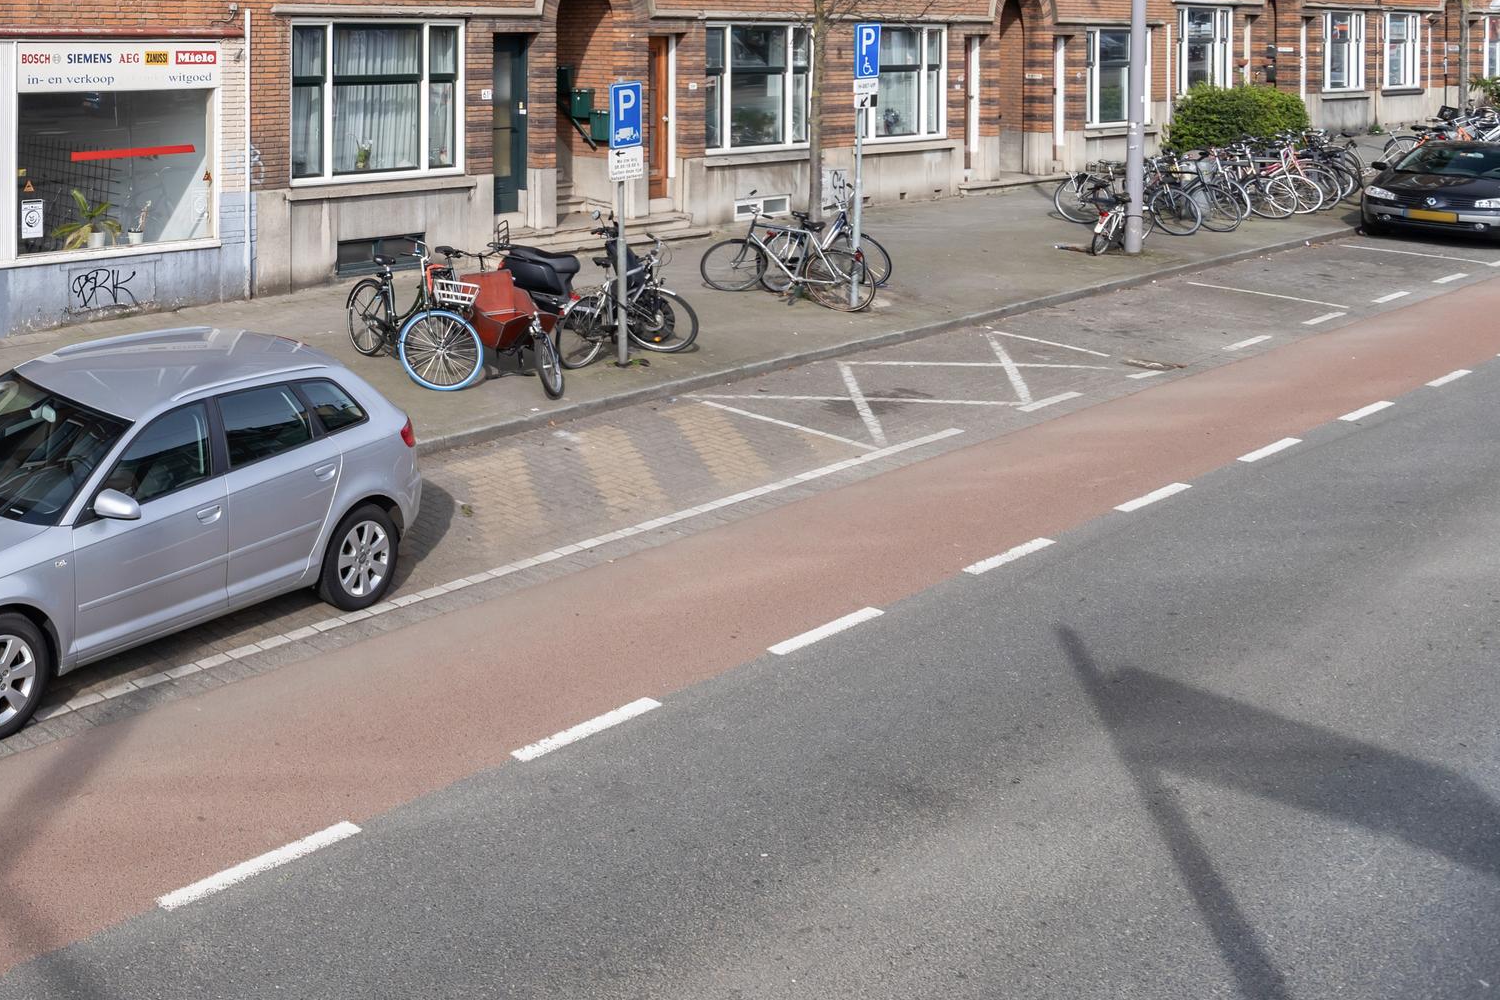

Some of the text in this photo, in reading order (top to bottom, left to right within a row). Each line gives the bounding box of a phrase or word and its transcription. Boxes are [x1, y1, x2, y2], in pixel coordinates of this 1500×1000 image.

[862, 28, 876, 56] P
[21, 52, 215, 64] BOSCH SIEMENS AEG ZANUSSI Miele
[27, 75, 44, 85] in-
[66, 75, 115, 86] verkoop
[168, 72, 212, 84] witgoed
[619, 89, 636, 121] P
